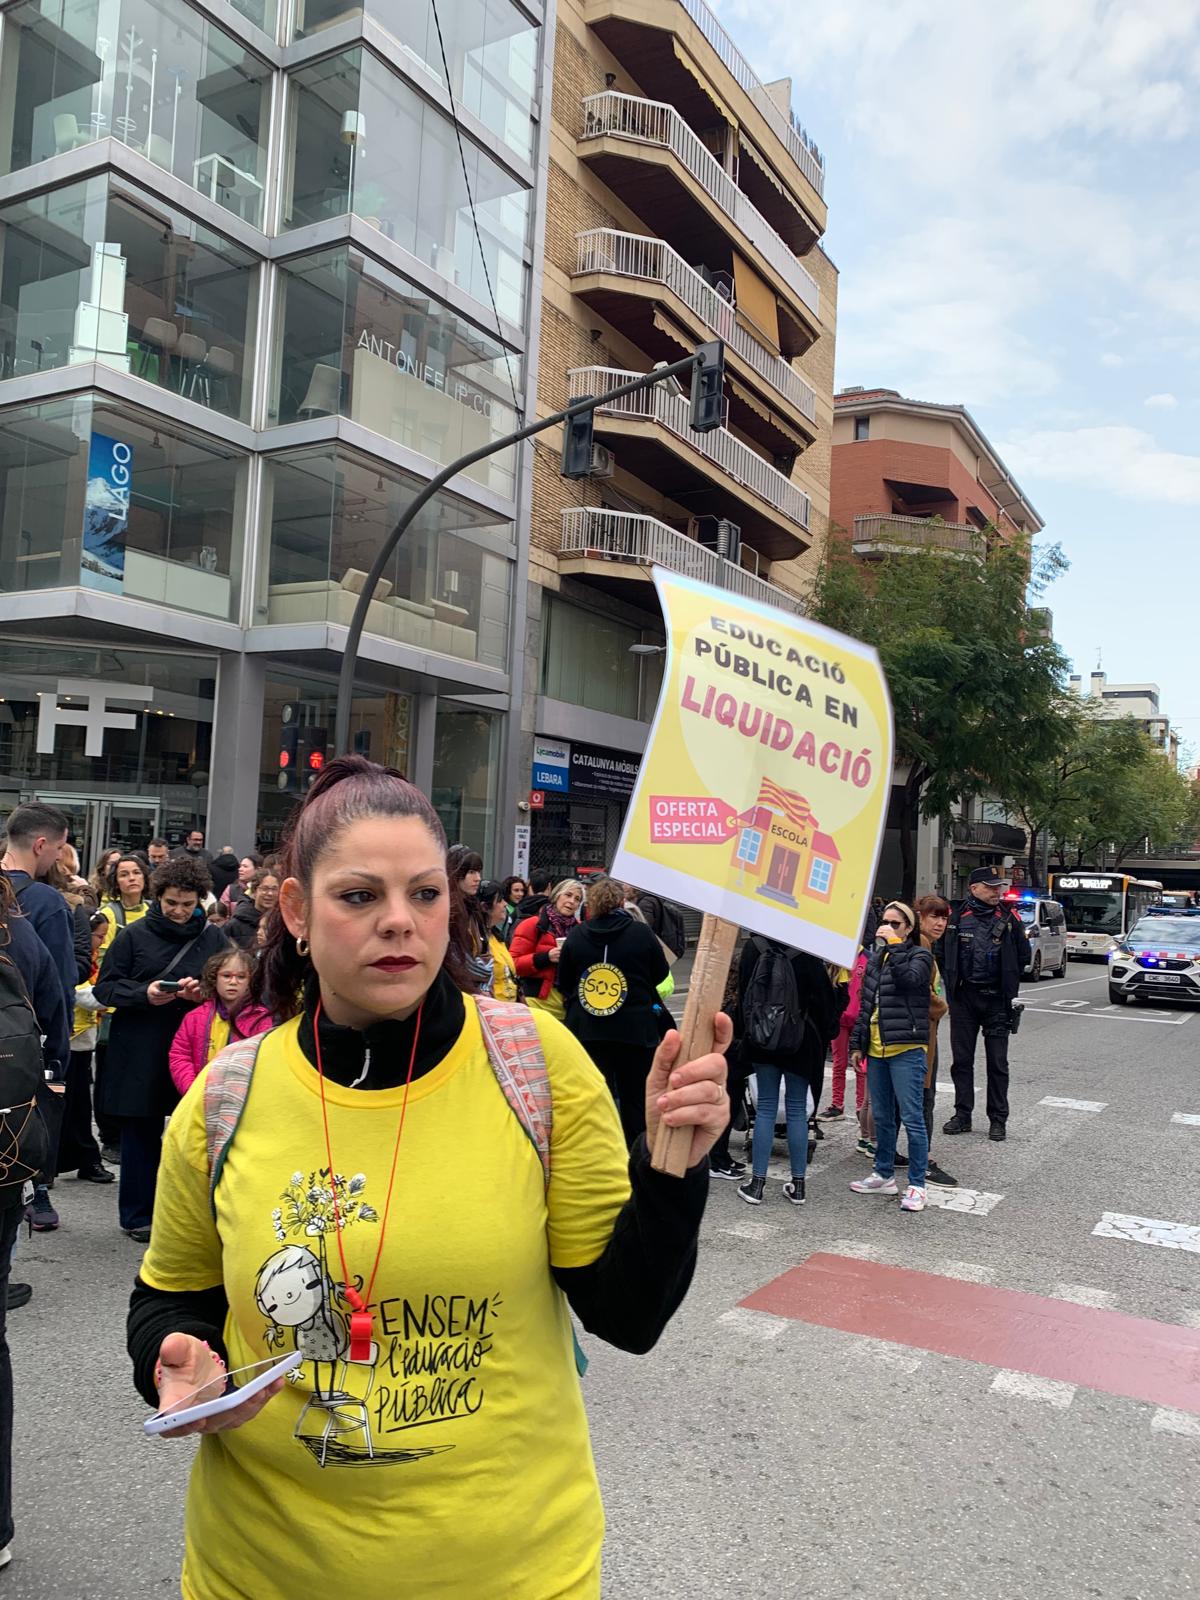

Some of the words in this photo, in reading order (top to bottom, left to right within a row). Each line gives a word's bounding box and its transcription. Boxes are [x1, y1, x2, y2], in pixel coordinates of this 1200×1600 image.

[108, 442, 131, 521] LAGO
[710, 616, 846, 685] EDUCACIÓ
[695, 637, 813, 708] PÚBLICA
[825, 695, 858, 729] EN
[680, 675, 872, 788] LIQUIDACIÓ
[572, 753, 615, 771] CATALUNYA
[536, 772, 563, 786] LEBARA
[656, 801, 718, 817] OFERTA
[654, 822, 727, 838] ESPECIAL
[771, 824, 808, 847] ESCOLA
[1060, 879, 1079, 888] 620
[585, 978, 620, 997] SOS
[345, 1294, 488, 1340] ENSEM
